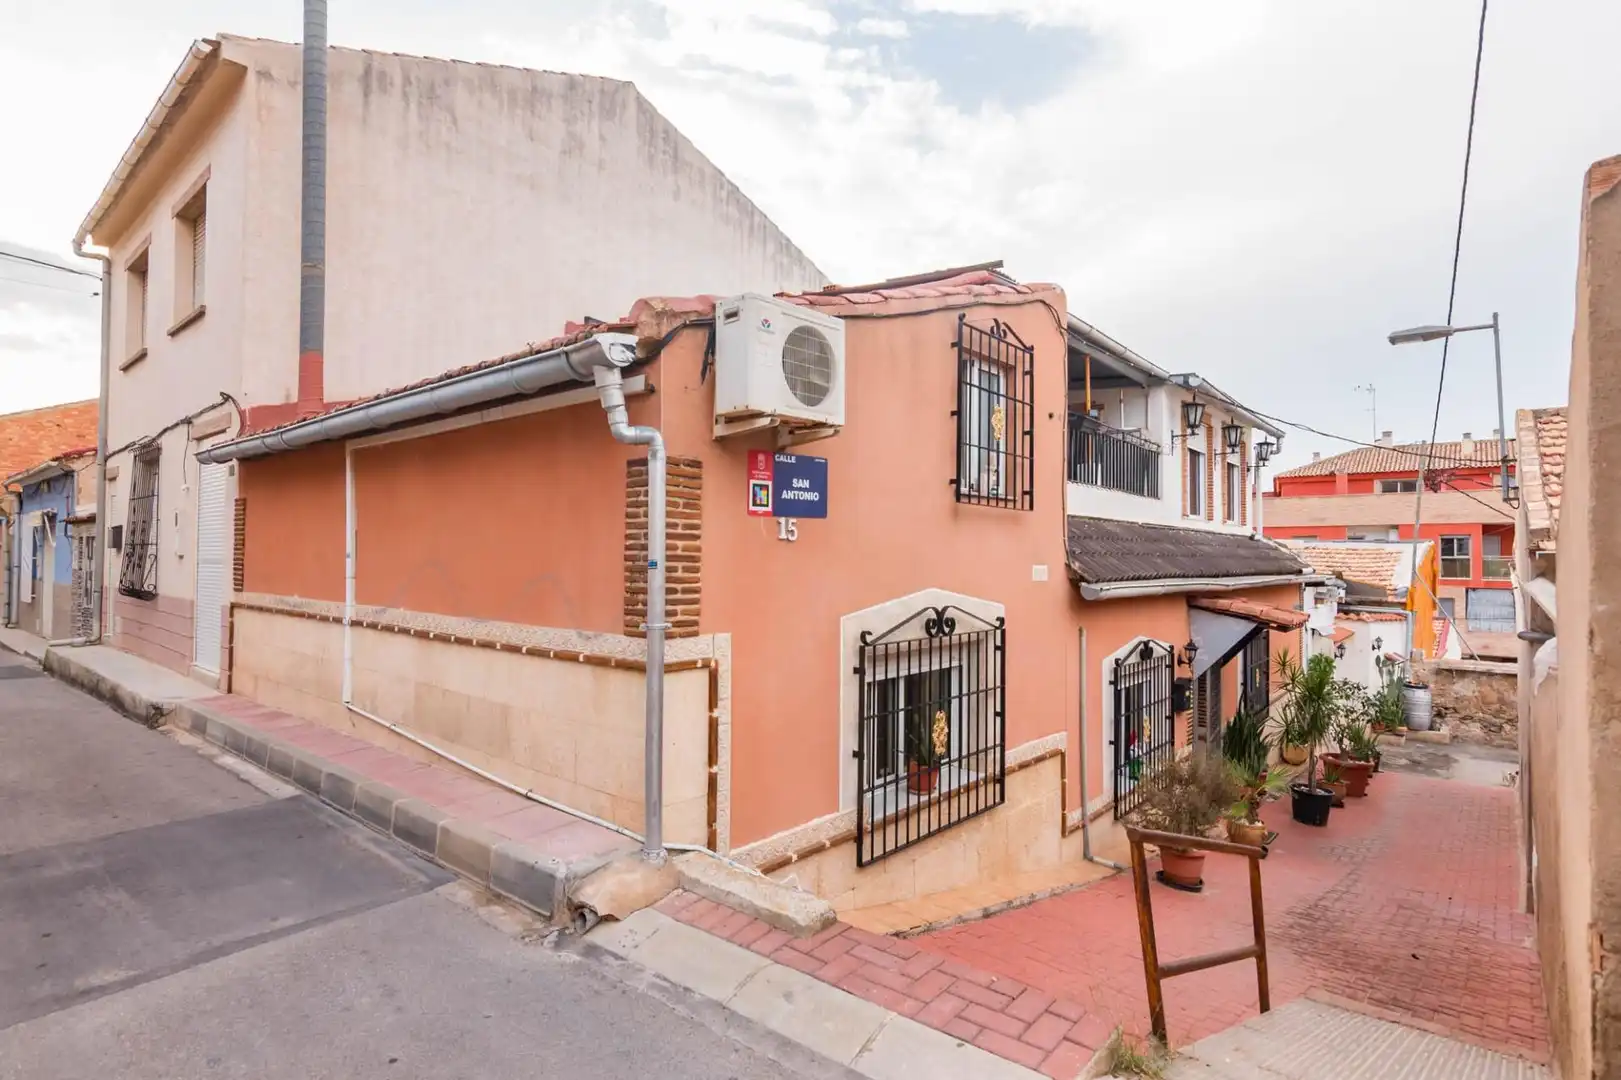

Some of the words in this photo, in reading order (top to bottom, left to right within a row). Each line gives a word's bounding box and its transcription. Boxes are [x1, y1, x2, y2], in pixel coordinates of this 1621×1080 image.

[775, 454, 796, 463] CALLE
[792, 478, 810, 488] SAN
[781, 490, 819, 501] ANTONIO
[777, 517, 798, 541] 15
